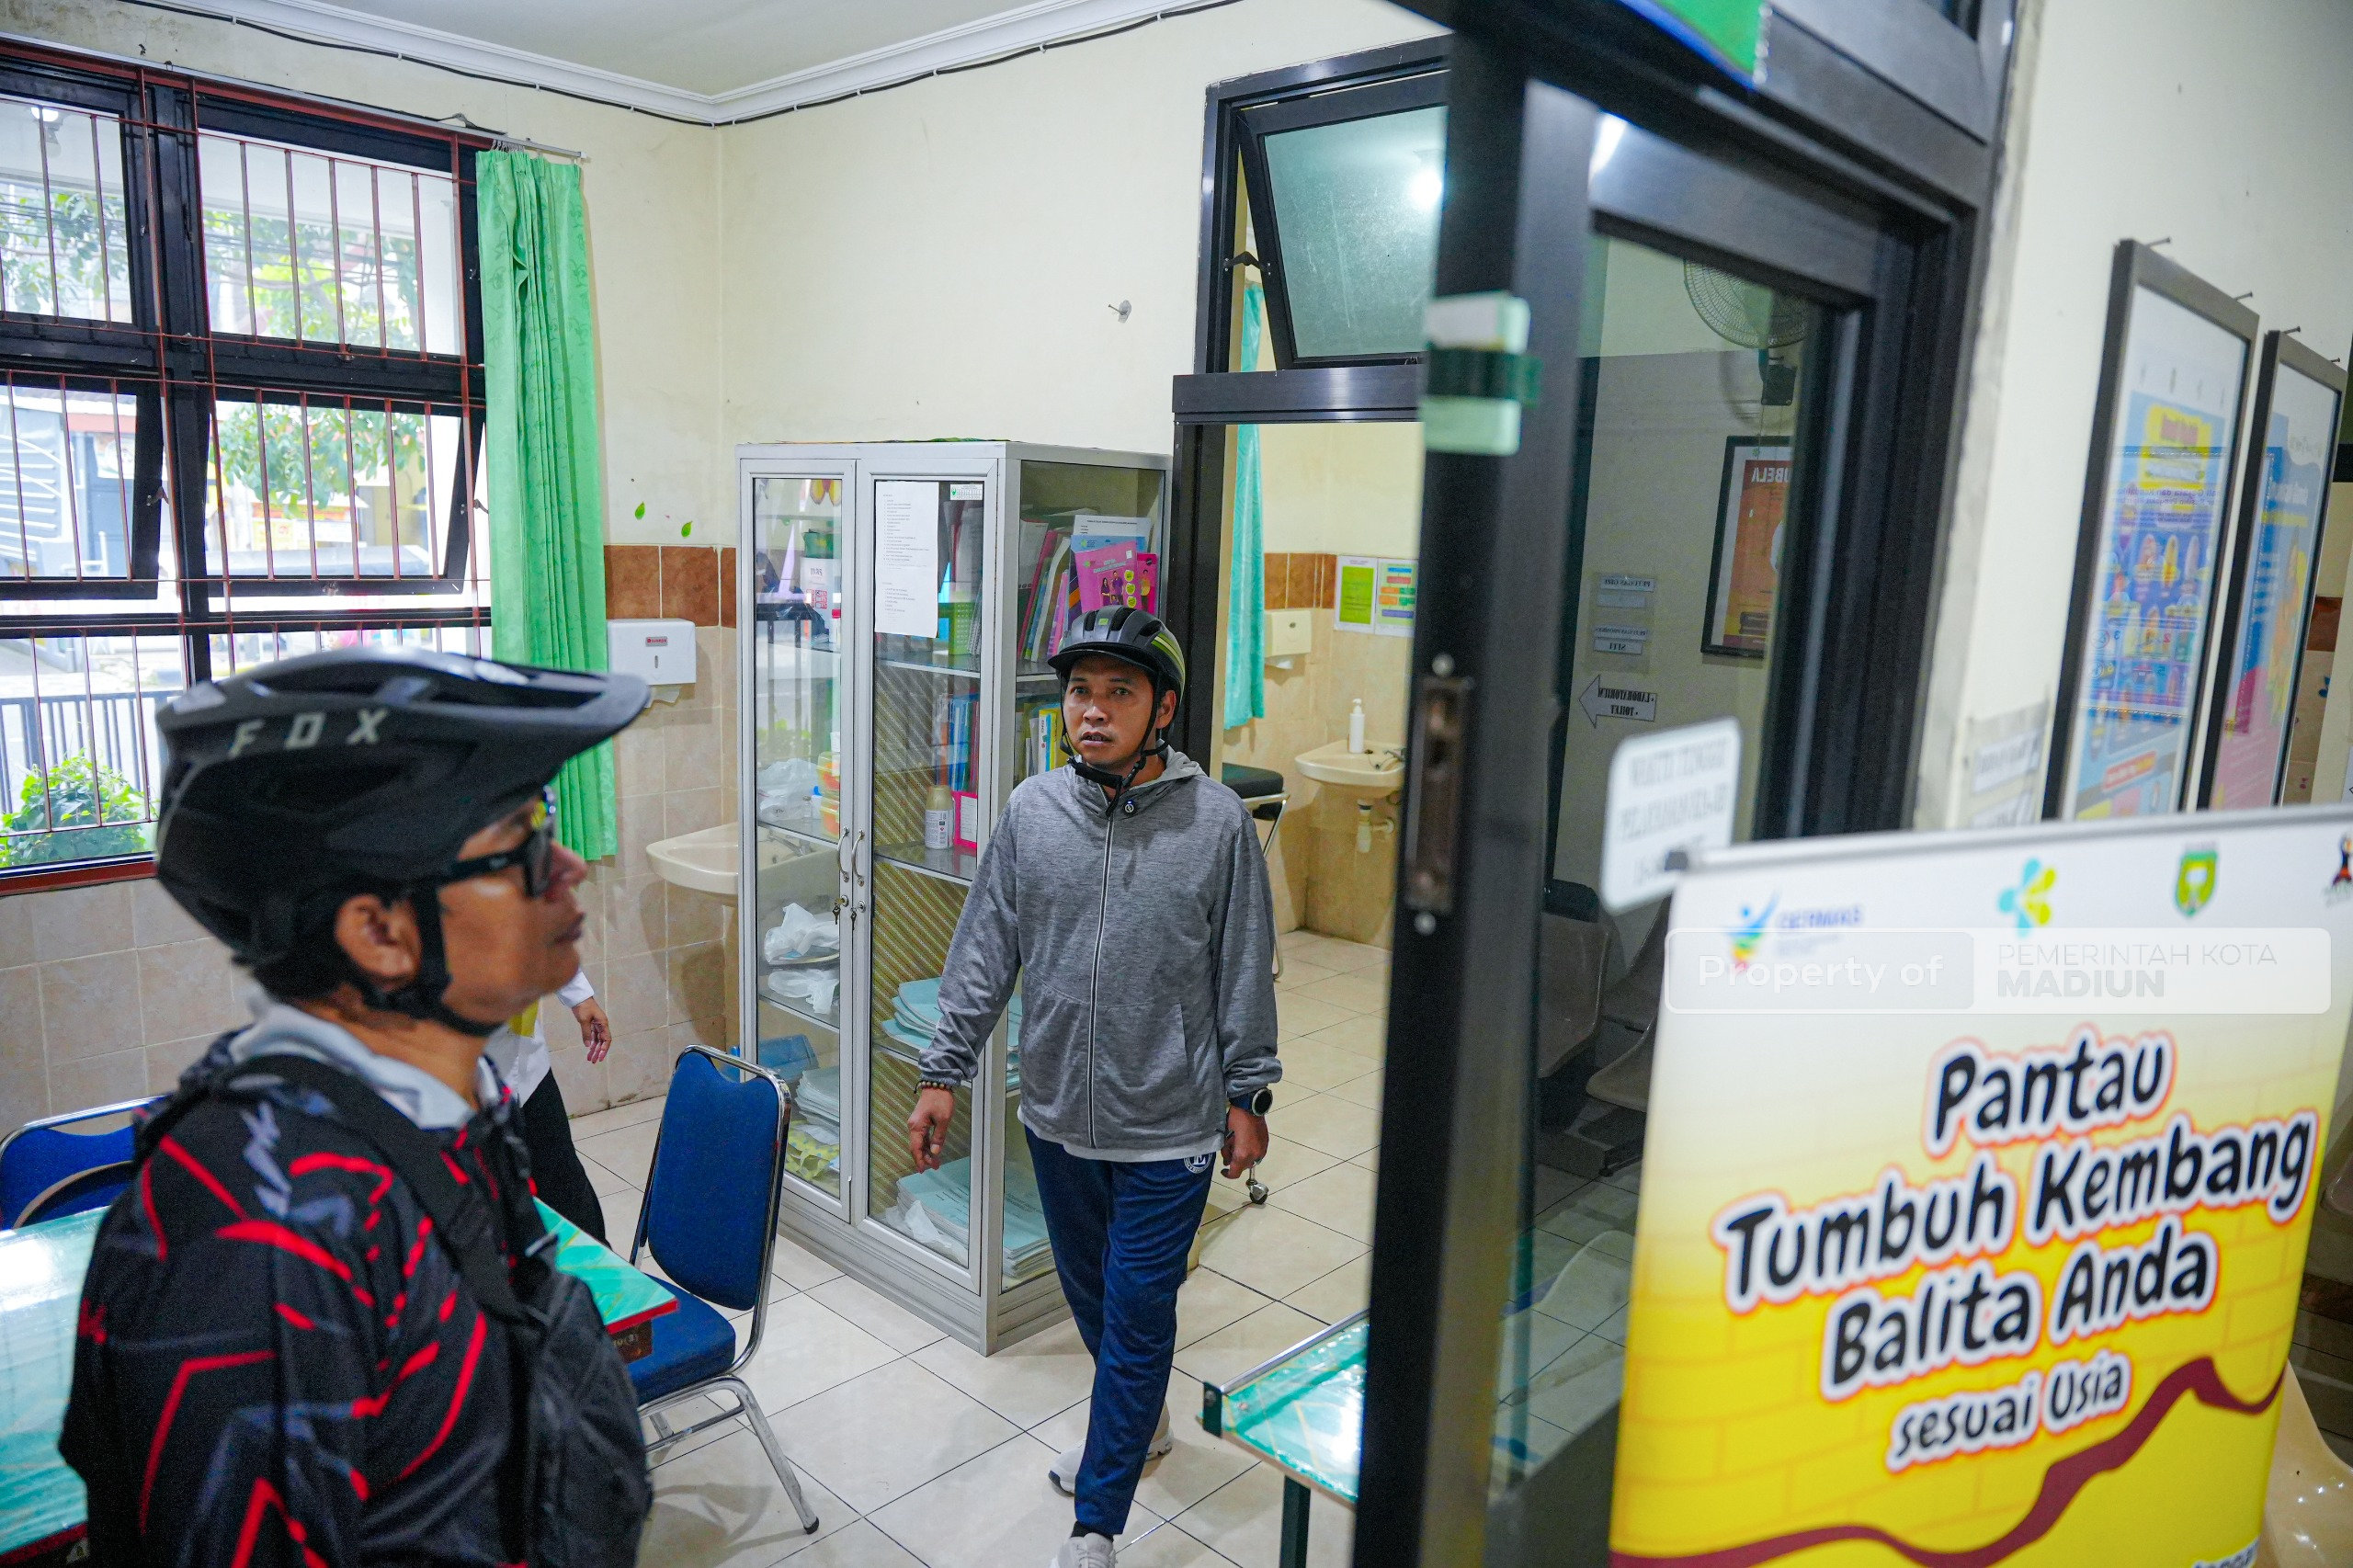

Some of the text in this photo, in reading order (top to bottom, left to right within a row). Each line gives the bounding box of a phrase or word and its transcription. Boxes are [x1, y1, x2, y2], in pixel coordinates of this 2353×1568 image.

[227, 707, 389, 760] FOX
[1934, 1040, 2165, 1142] Pantau
[1725, 1121, 2311, 1297] Tumbuh Kembang
[1833, 1224, 2209, 1386] Balita Anda
[1895, 1360, 2123, 1459] sesuai Usia
